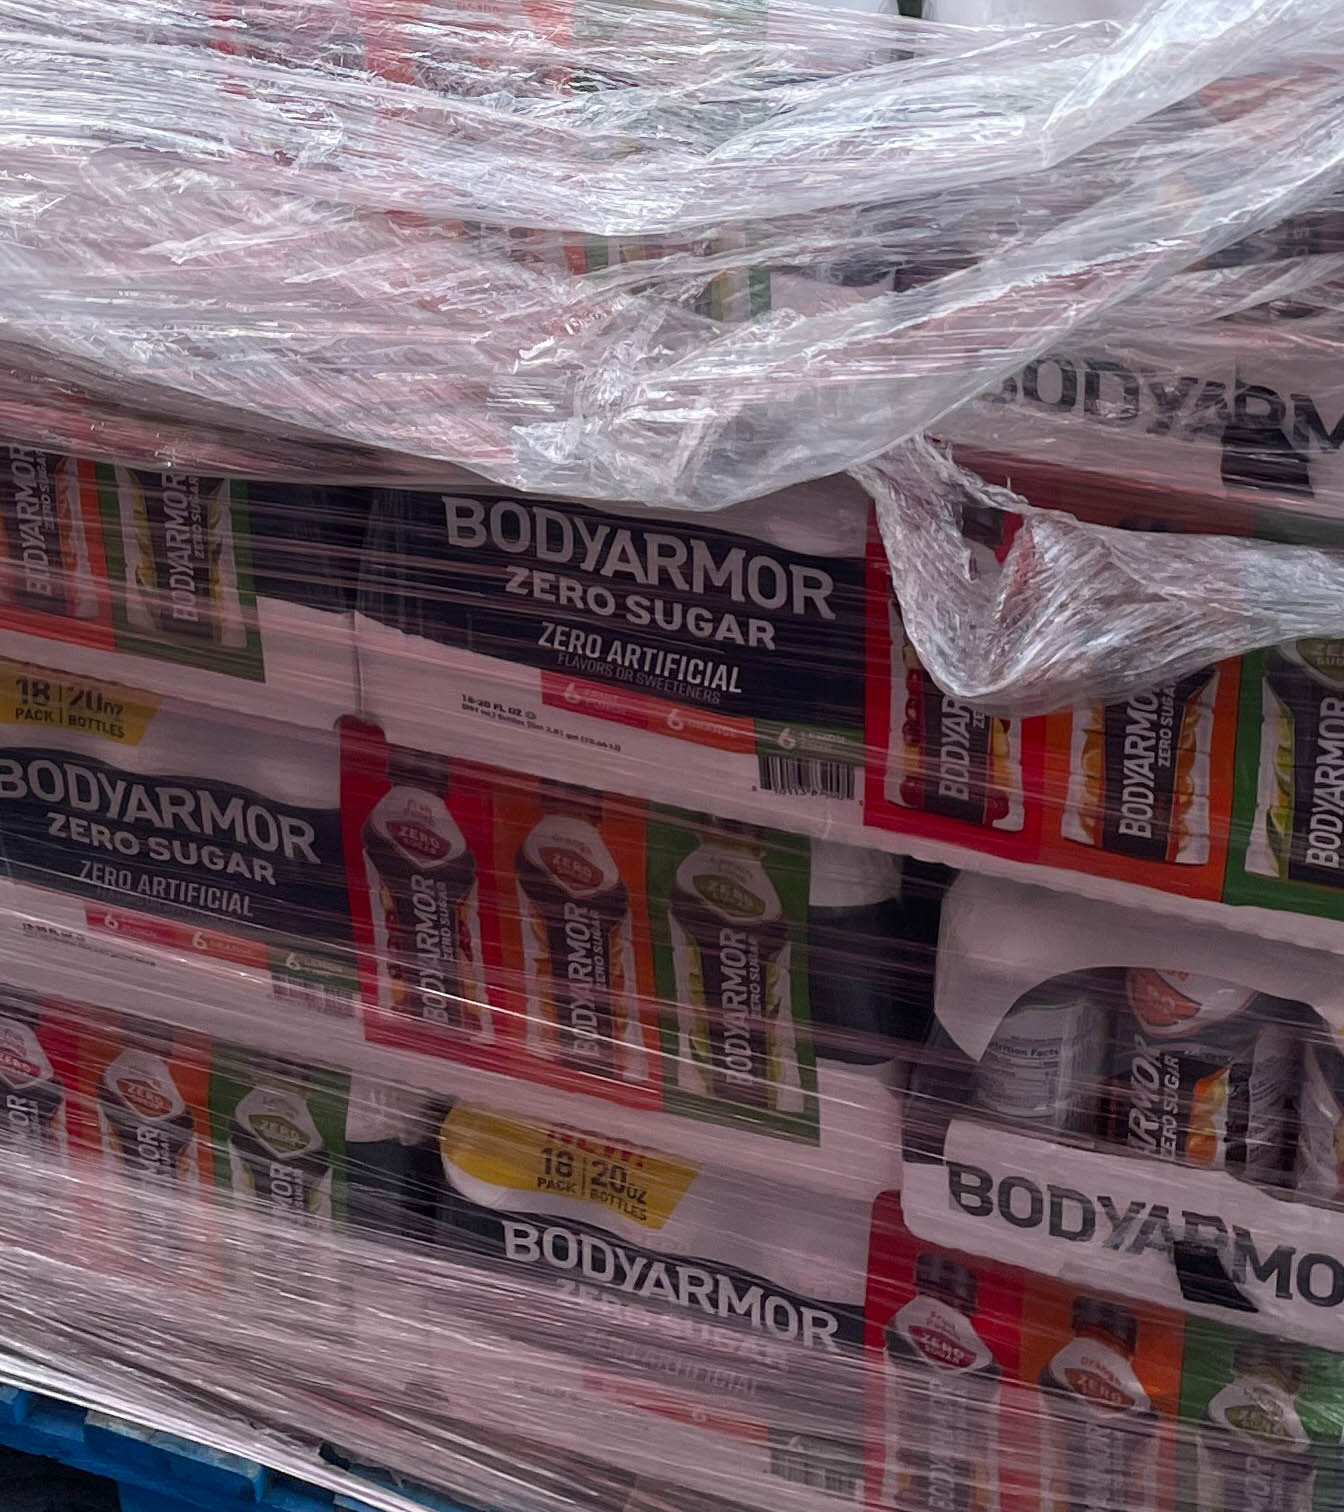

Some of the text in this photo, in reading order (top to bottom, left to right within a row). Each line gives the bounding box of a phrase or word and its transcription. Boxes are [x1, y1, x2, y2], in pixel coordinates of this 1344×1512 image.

[161, 470, 201, 623] BODYARMOR
[441, 495, 837, 621] BODYARMOR
[504, 564, 777, 651] ZERO SUGAR
[537, 621, 743, 694] ZERO ARTIFICIAL
[556, 654, 722, 705] FLAVORS OR SWEETENERS
[14, 706, 126, 740] PACK BOTTLES
[563, 682, 582, 705] 6
[666, 707, 685, 730] 6
[778, 726, 796, 750] 6
[1157, 730, 1173, 770] ZERO
[47, 812, 276, 886] ZERO SUGAR
[397, 824, 442, 851] ZERO
[78, 858, 255, 918] ZERO ARTIFICIAL
[102, 908, 120, 931] 6
[191, 929, 209, 951] 6
[411, 873, 449, 1025] BODYARMOR
[564, 901, 601, 1058] BODYARMOR
[719, 926, 754, 1085] BODYARMOR
[1163, 1054, 1181, 1114] SUGAR
[536, 1176, 648, 1222] PACK BOTTLES
[501, 1219, 840, 1352] BODYARMOR
